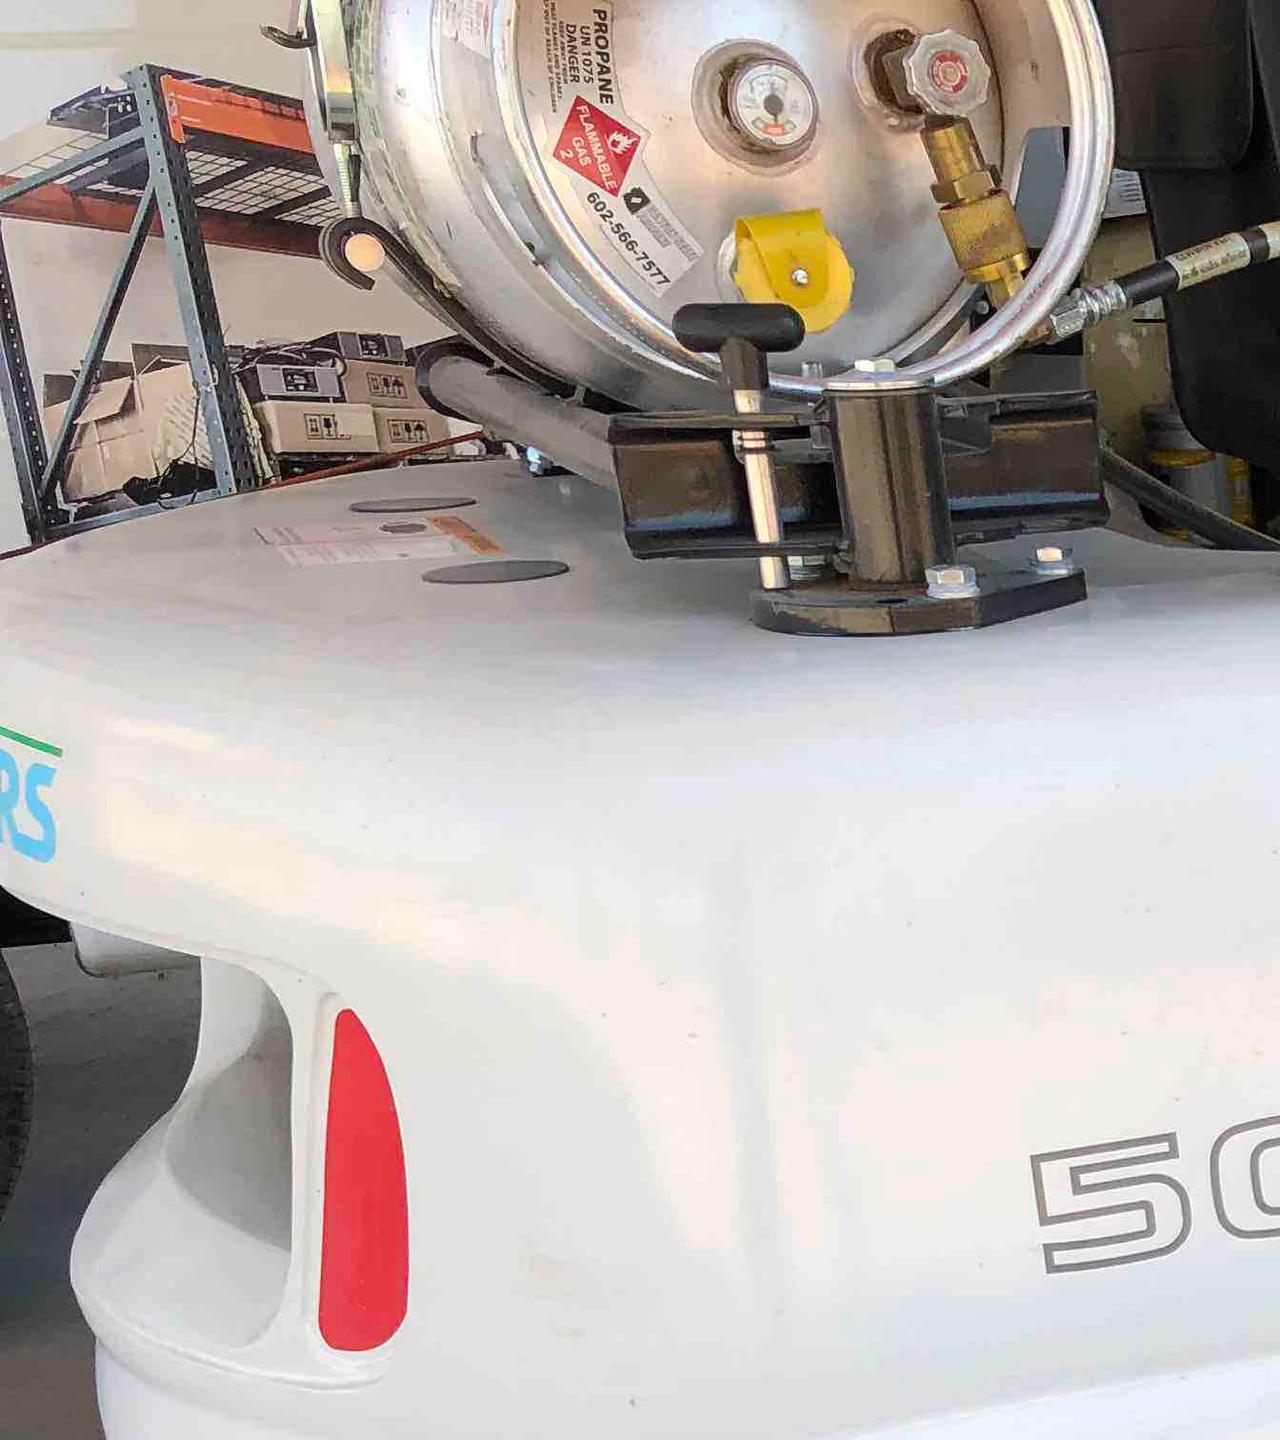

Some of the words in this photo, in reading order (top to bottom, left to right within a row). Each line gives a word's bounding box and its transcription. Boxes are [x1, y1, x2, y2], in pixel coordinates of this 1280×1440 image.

[565, 23, 581, 84] DANGER
[580, 25, 592, 46] UN
[593, 8, 614, 104] PROPANE
[581, 51, 595, 84] 1075
[560, 149, 574, 159] 2
[571, 136, 593, 167] GAS
[576, 105, 619, 191] FLAMMABLE
[586, 191, 671, 286] 602-566-7577
